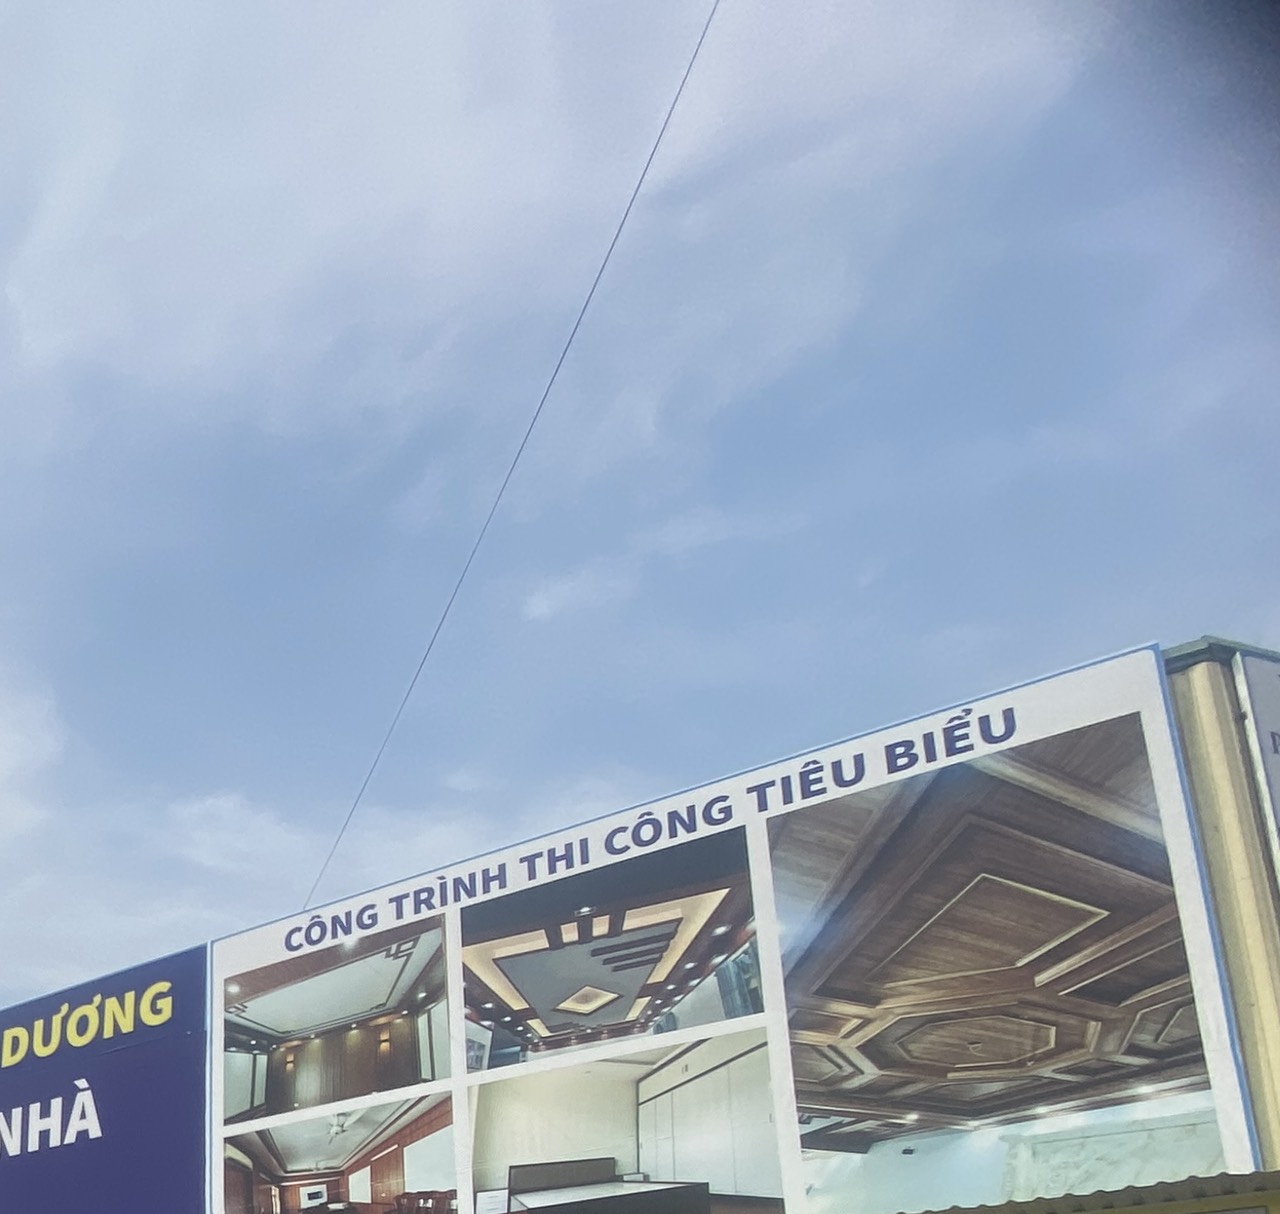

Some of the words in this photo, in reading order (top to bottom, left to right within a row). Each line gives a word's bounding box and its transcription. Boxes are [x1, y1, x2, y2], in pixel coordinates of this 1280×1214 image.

[284, 904, 379, 951] CÔNG
[388, 862, 507, 920] TRÌNH
[519, 838, 589, 881] THI
[604, 795, 733, 855] CÔNG
[746, 753, 865, 812] TIÊU
[885, 707, 1017, 774] BIỂU
[1, 981, 172, 1067] DƯƠNG
